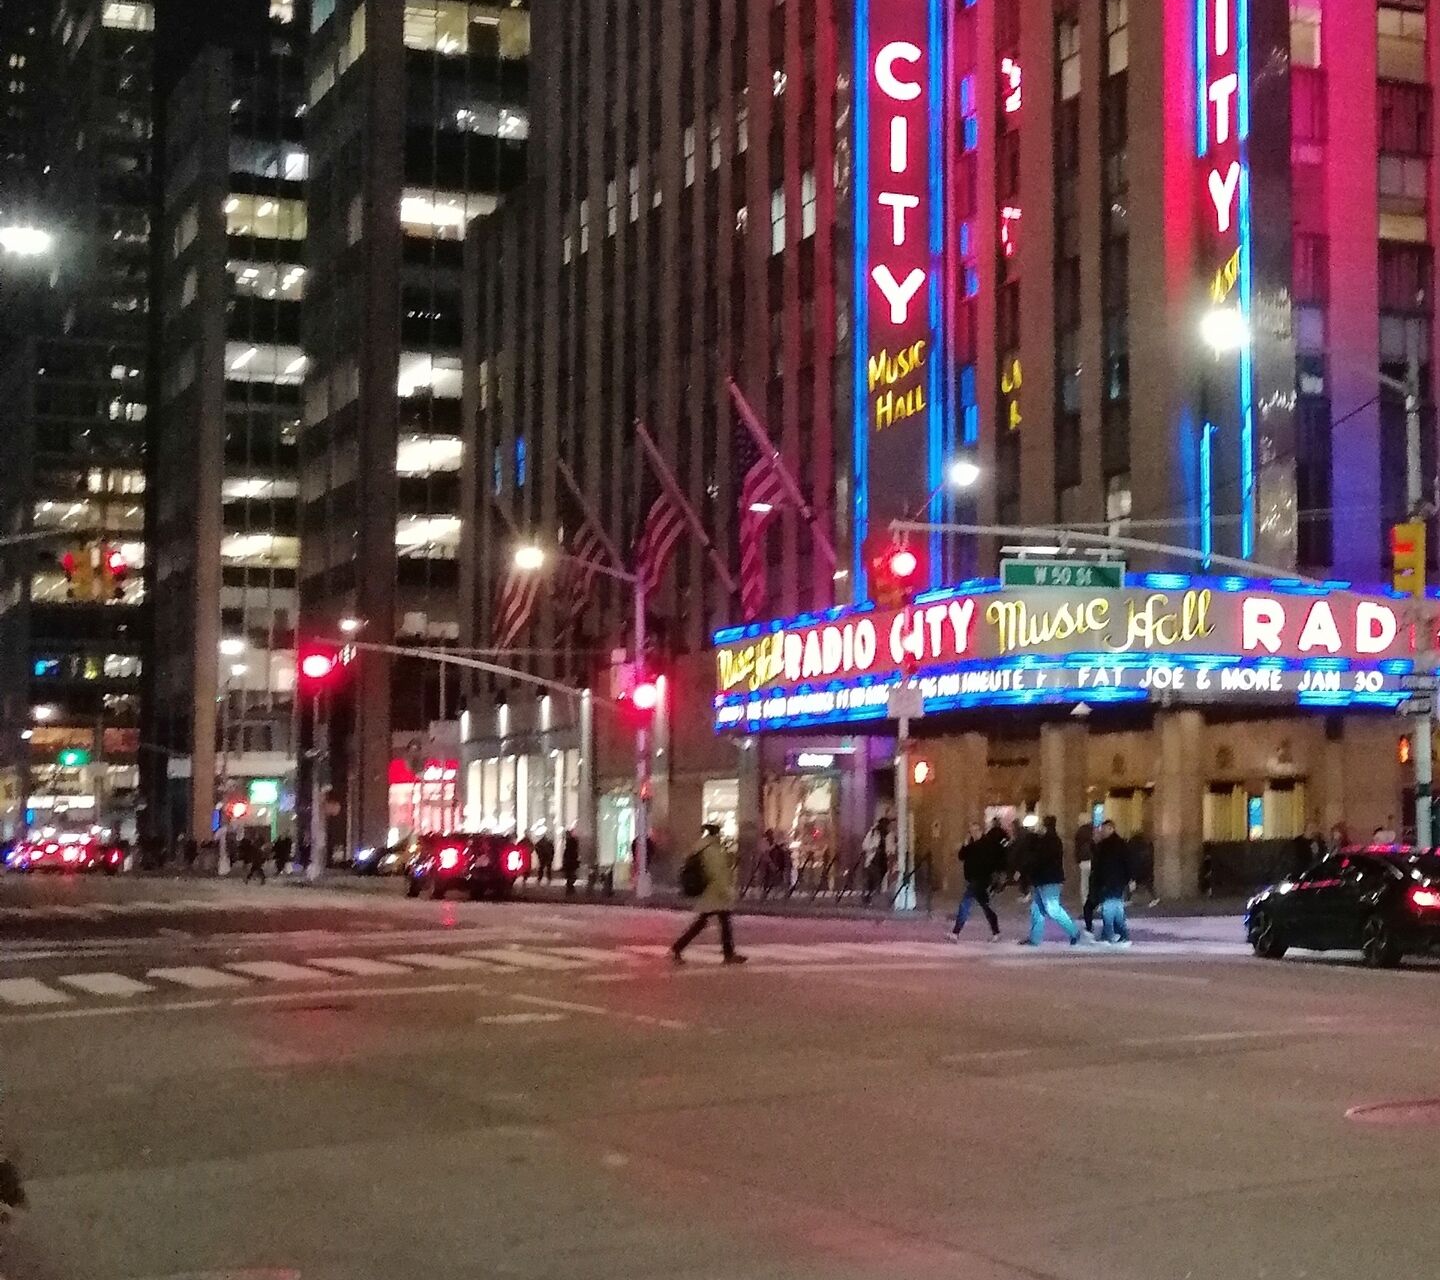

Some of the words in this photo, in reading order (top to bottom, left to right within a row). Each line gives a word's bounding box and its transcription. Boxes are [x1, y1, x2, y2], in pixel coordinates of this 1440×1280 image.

[872, 41, 926, 324] CITY
[875, 390, 927, 431] HALL
[1034, 566, 1048, 585] W
[1051, 566, 1072, 585] 50
[986, 597, 1110, 655] Music
[1104, 588, 1216, 654] Hall
[784, 619, 876, 681] RADIO
[1078, 666, 1126, 689] FAT
[1138, 666, 1185, 690] JOE
[1221, 668, 1283, 692] MORE
[1297, 670, 1341, 692] JAN
[1354, 670, 1384, 693] 30
